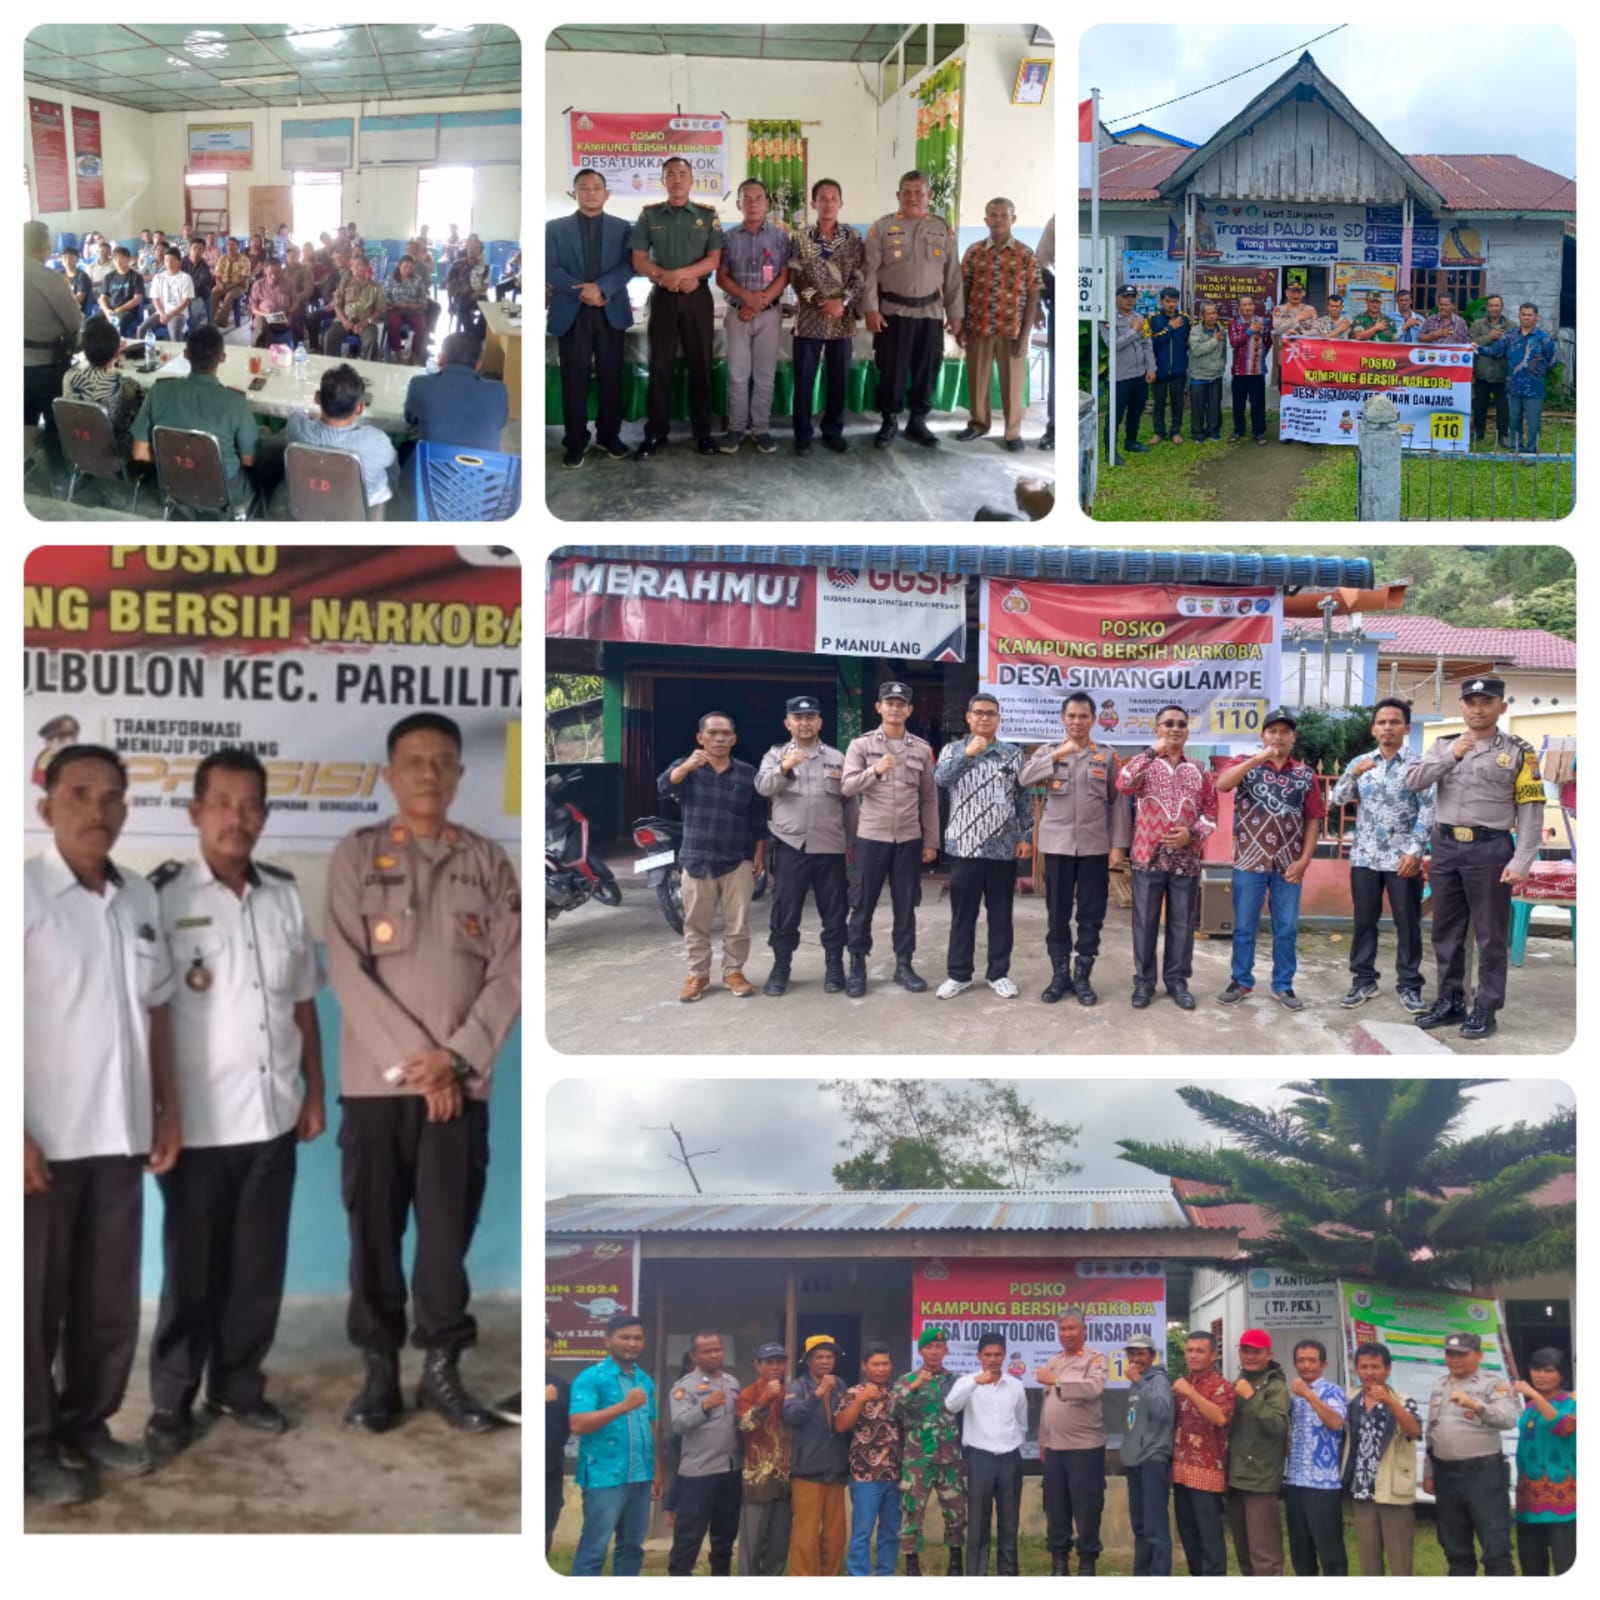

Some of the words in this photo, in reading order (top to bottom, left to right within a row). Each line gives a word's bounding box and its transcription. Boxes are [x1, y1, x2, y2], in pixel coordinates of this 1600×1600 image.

[630, 131, 665, 140] POSKO
[576, 142, 630, 152] KAMPUNG
[631, 144, 668, 153] BERSIH
[581, 156, 620, 168] DESA
[695, 178, 718, 190] 110
[1214, 220, 1269, 236] Transisi
[1274, 222, 1314, 236] PAUD
[1320, 223, 1337, 236] ke
[1344, 224, 1364, 238] SD
[1360, 356, 1396, 370] POSKO
[1304, 370, 1356, 385] KAMPUNG
[1359, 372, 1399, 387] BERSIH
[1402, 376, 1452, 390] NARKOBA
[1293, 386, 1315, 400] DESA
[1434, 423, 1459, 438] 110
[572, 562, 800, 608] MERAHMU!
[109, 588, 290, 639] BERSIH
[1101, 620, 1166, 638] POSKO
[822, 637, 832, 650] P
[835, 638, 921, 655] MANULANG
[998, 638, 1098, 658] KAMPUNG
[1102, 642, 1168, 660] BERSIH
[1172, 643, 1262, 662] NARKOBA
[24, 651, 204, 698] LBULON
[223, 658, 318, 703] KEC.
[336, 663, 521, 707] PARLILIT
[1000, 666, 1061, 688] DESA
[1068, 668, 1262, 690] SIMANGULAMPE
[114, 718, 241, 738] TRANSFORMASI
[1216, 709, 1259, 730] 110
[116, 737, 184, 754] MENUJU
[121, 756, 380, 797] PRSISI
[576, 1284, 619, 1294] 2024
[1010, 1282, 1066, 1296] POSKO
[920, 1302, 1006, 1316] KAMPUNG
[1010, 1302, 1069, 1316] BERSIH
[1290, 1300, 1314, 1312] PKK
